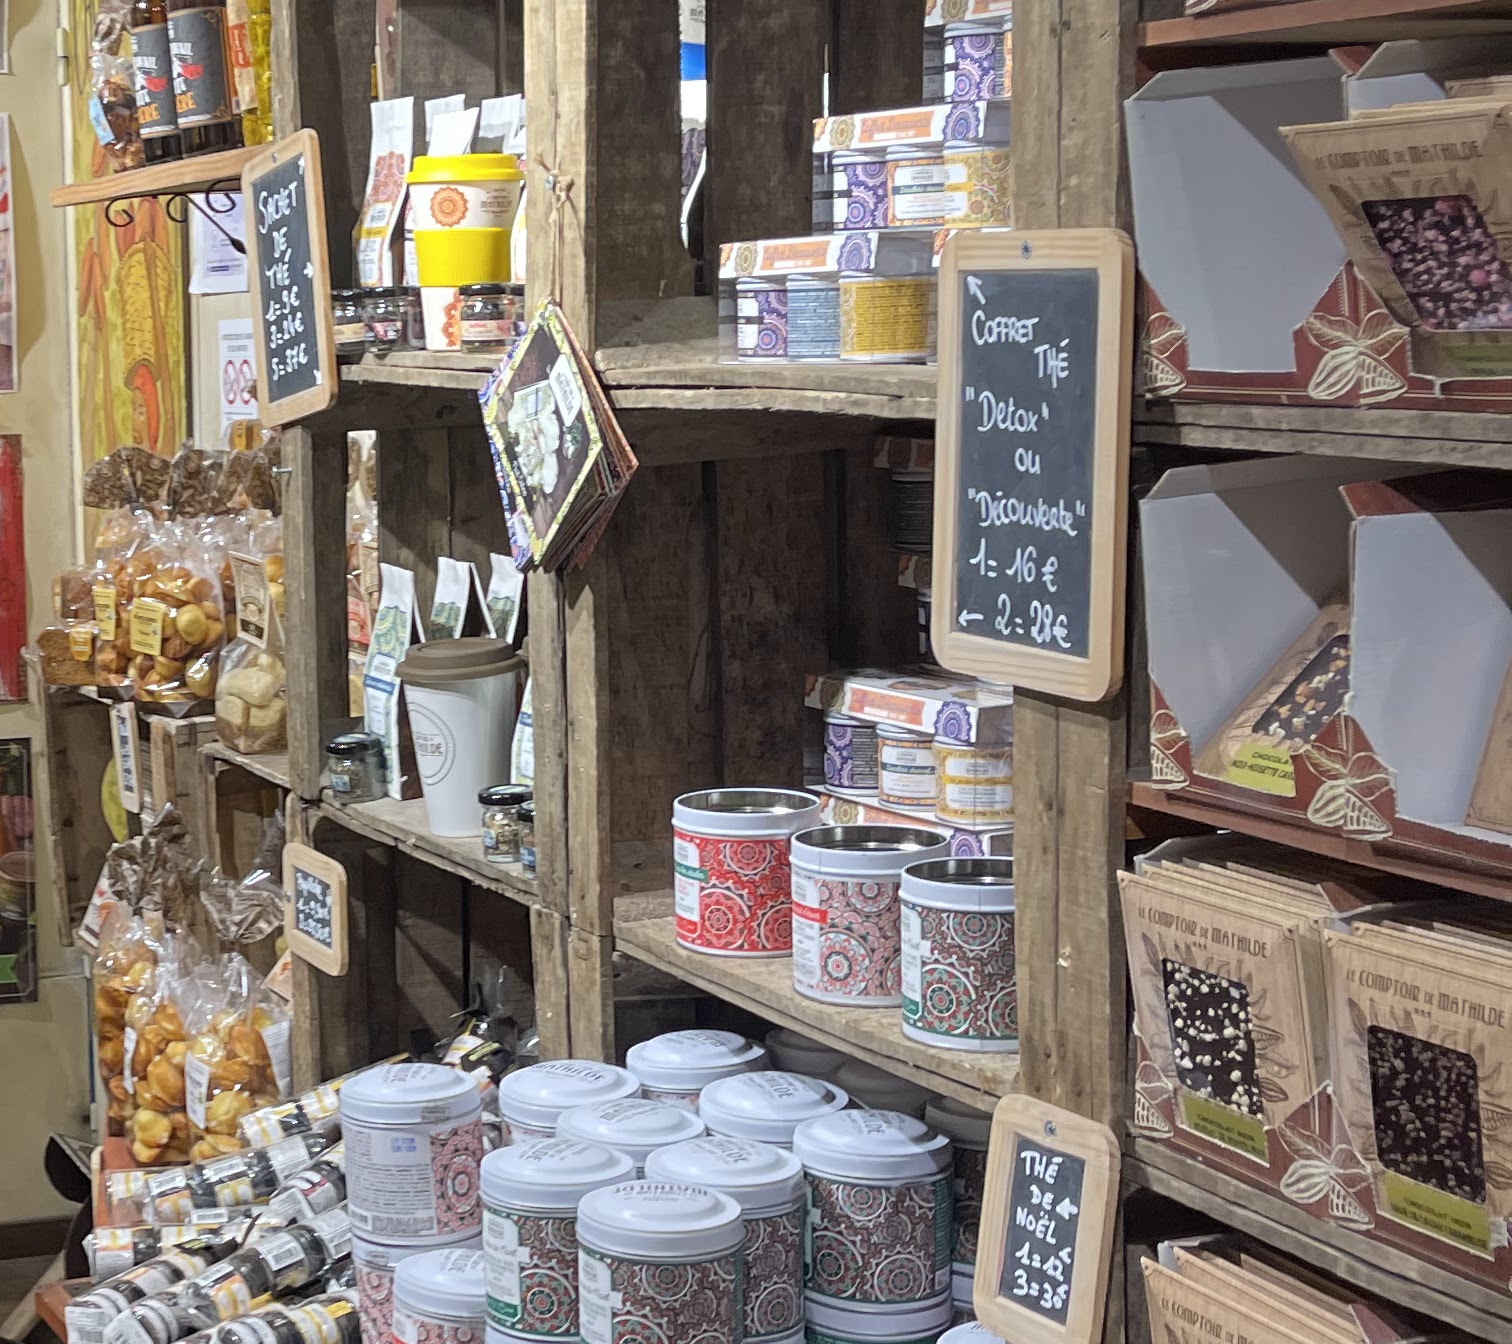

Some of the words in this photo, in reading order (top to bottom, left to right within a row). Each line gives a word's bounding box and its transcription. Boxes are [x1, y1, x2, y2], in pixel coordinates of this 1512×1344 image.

[1408, 141, 1483, 164] MATHILDE
[1033, 338, 1070, 388] THÉ
[1148, 907, 1197, 936] COMPTOIR
[1211, 927, 1267, 959] MATHILDE
[1359, 969, 1420, 1002] COMPTOIR
[1438, 992, 1505, 1028] MATHILDE
[1021, 1150, 1063, 1184] THÉ
[1030, 1185, 1054, 1210] DE
[1015, 1207, 1056, 1244] NOËL
[1171, 1301, 1222, 1339] COMPTOIR
